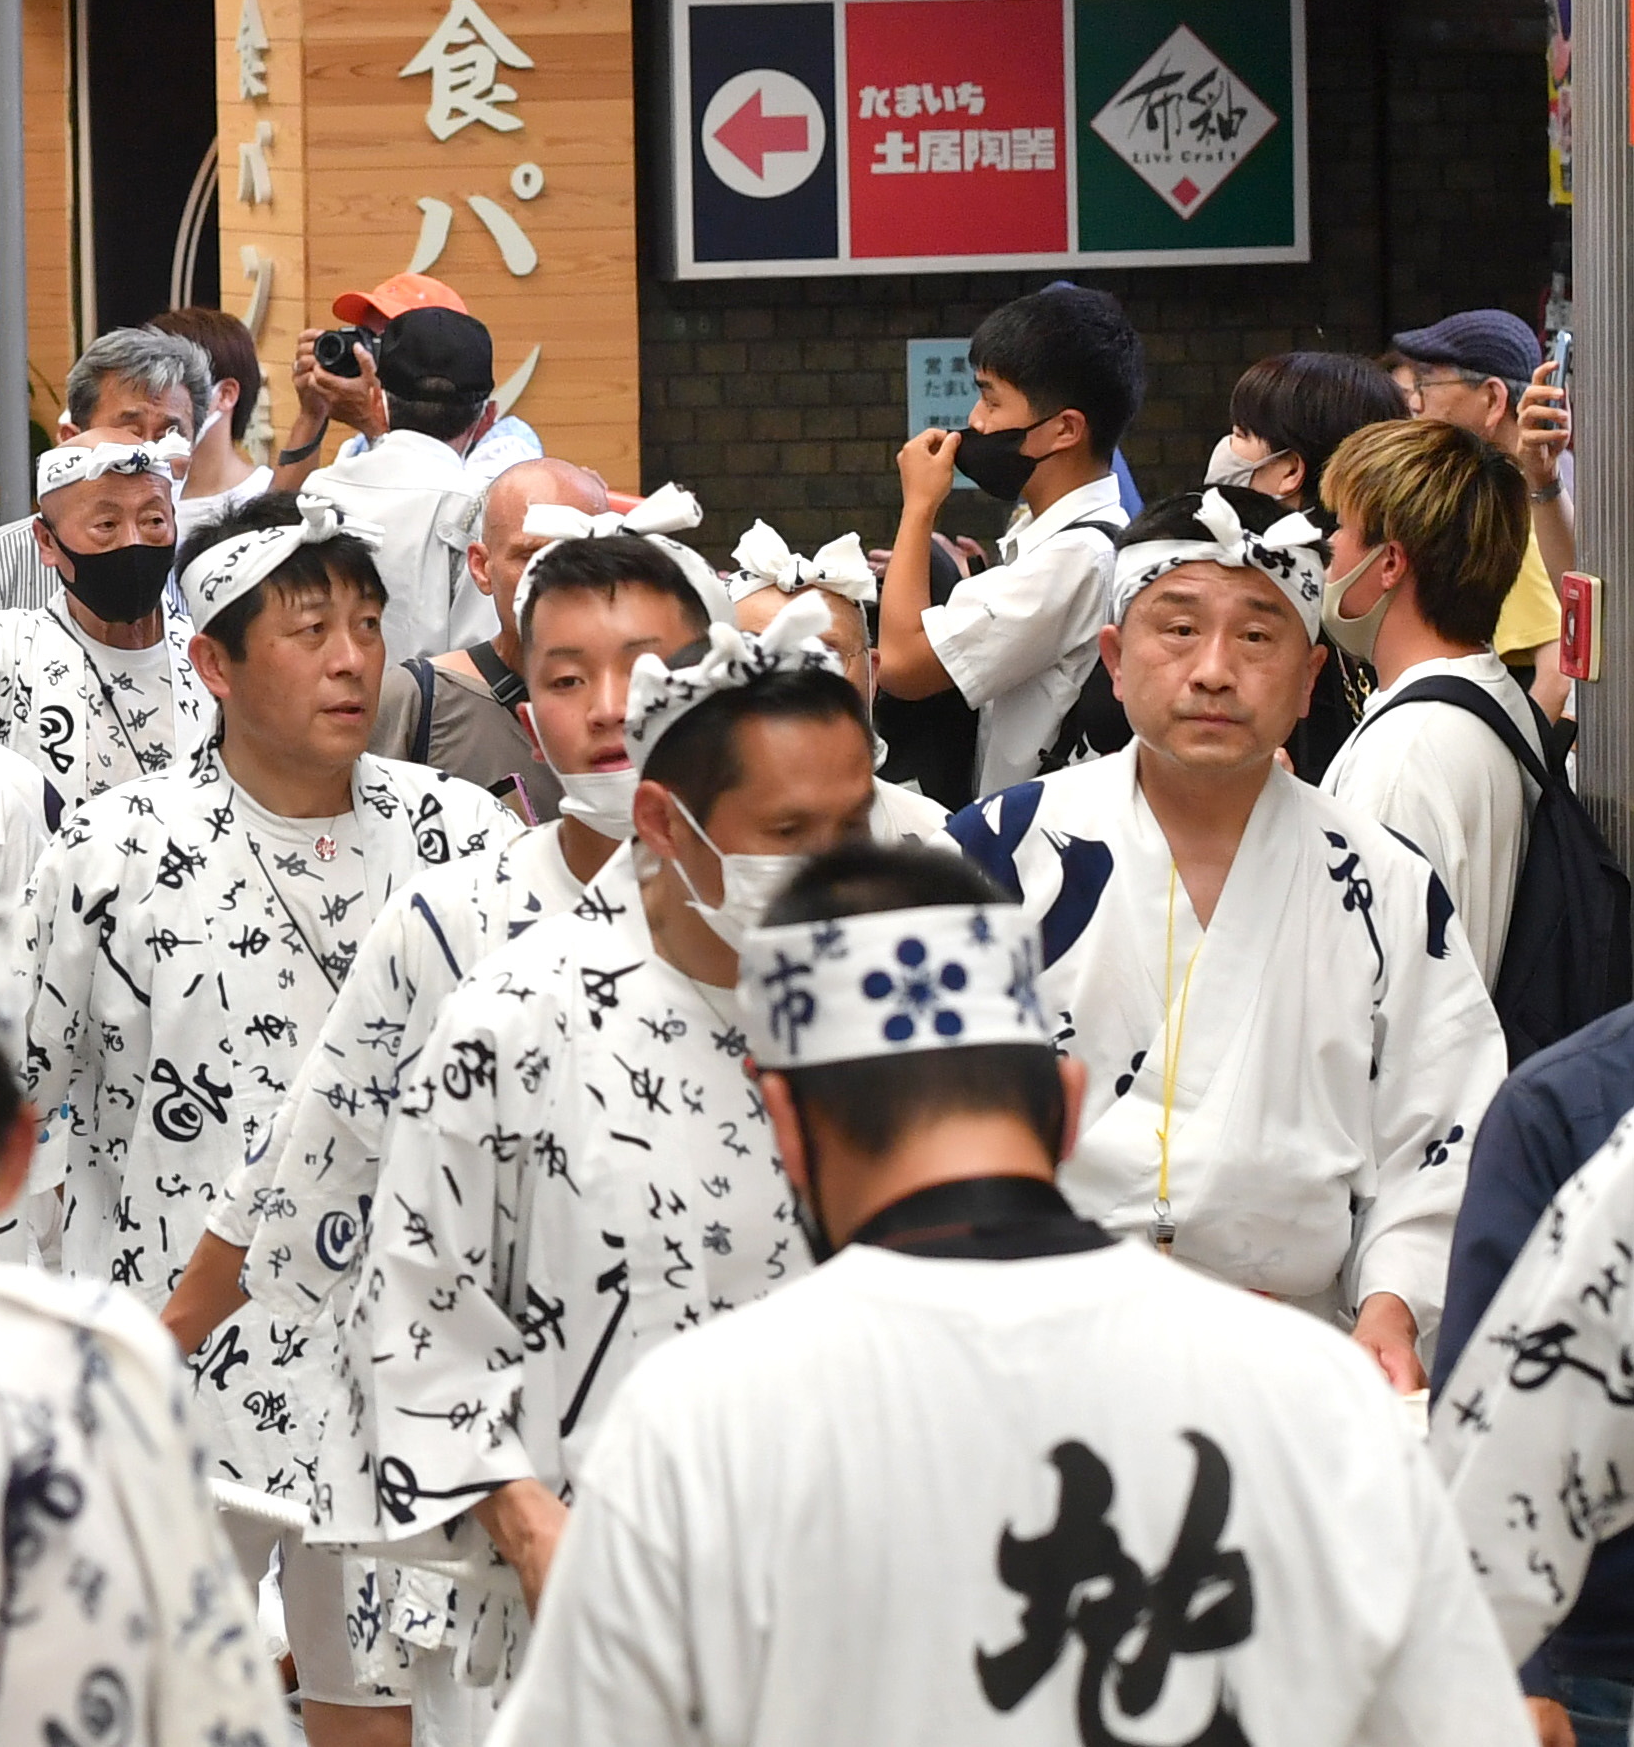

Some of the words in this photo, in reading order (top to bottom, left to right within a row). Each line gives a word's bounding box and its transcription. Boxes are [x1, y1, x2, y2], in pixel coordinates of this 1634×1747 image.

[858, 82, 986, 119] たまいち
[870, 126, 1057, 175] 土居陶器
